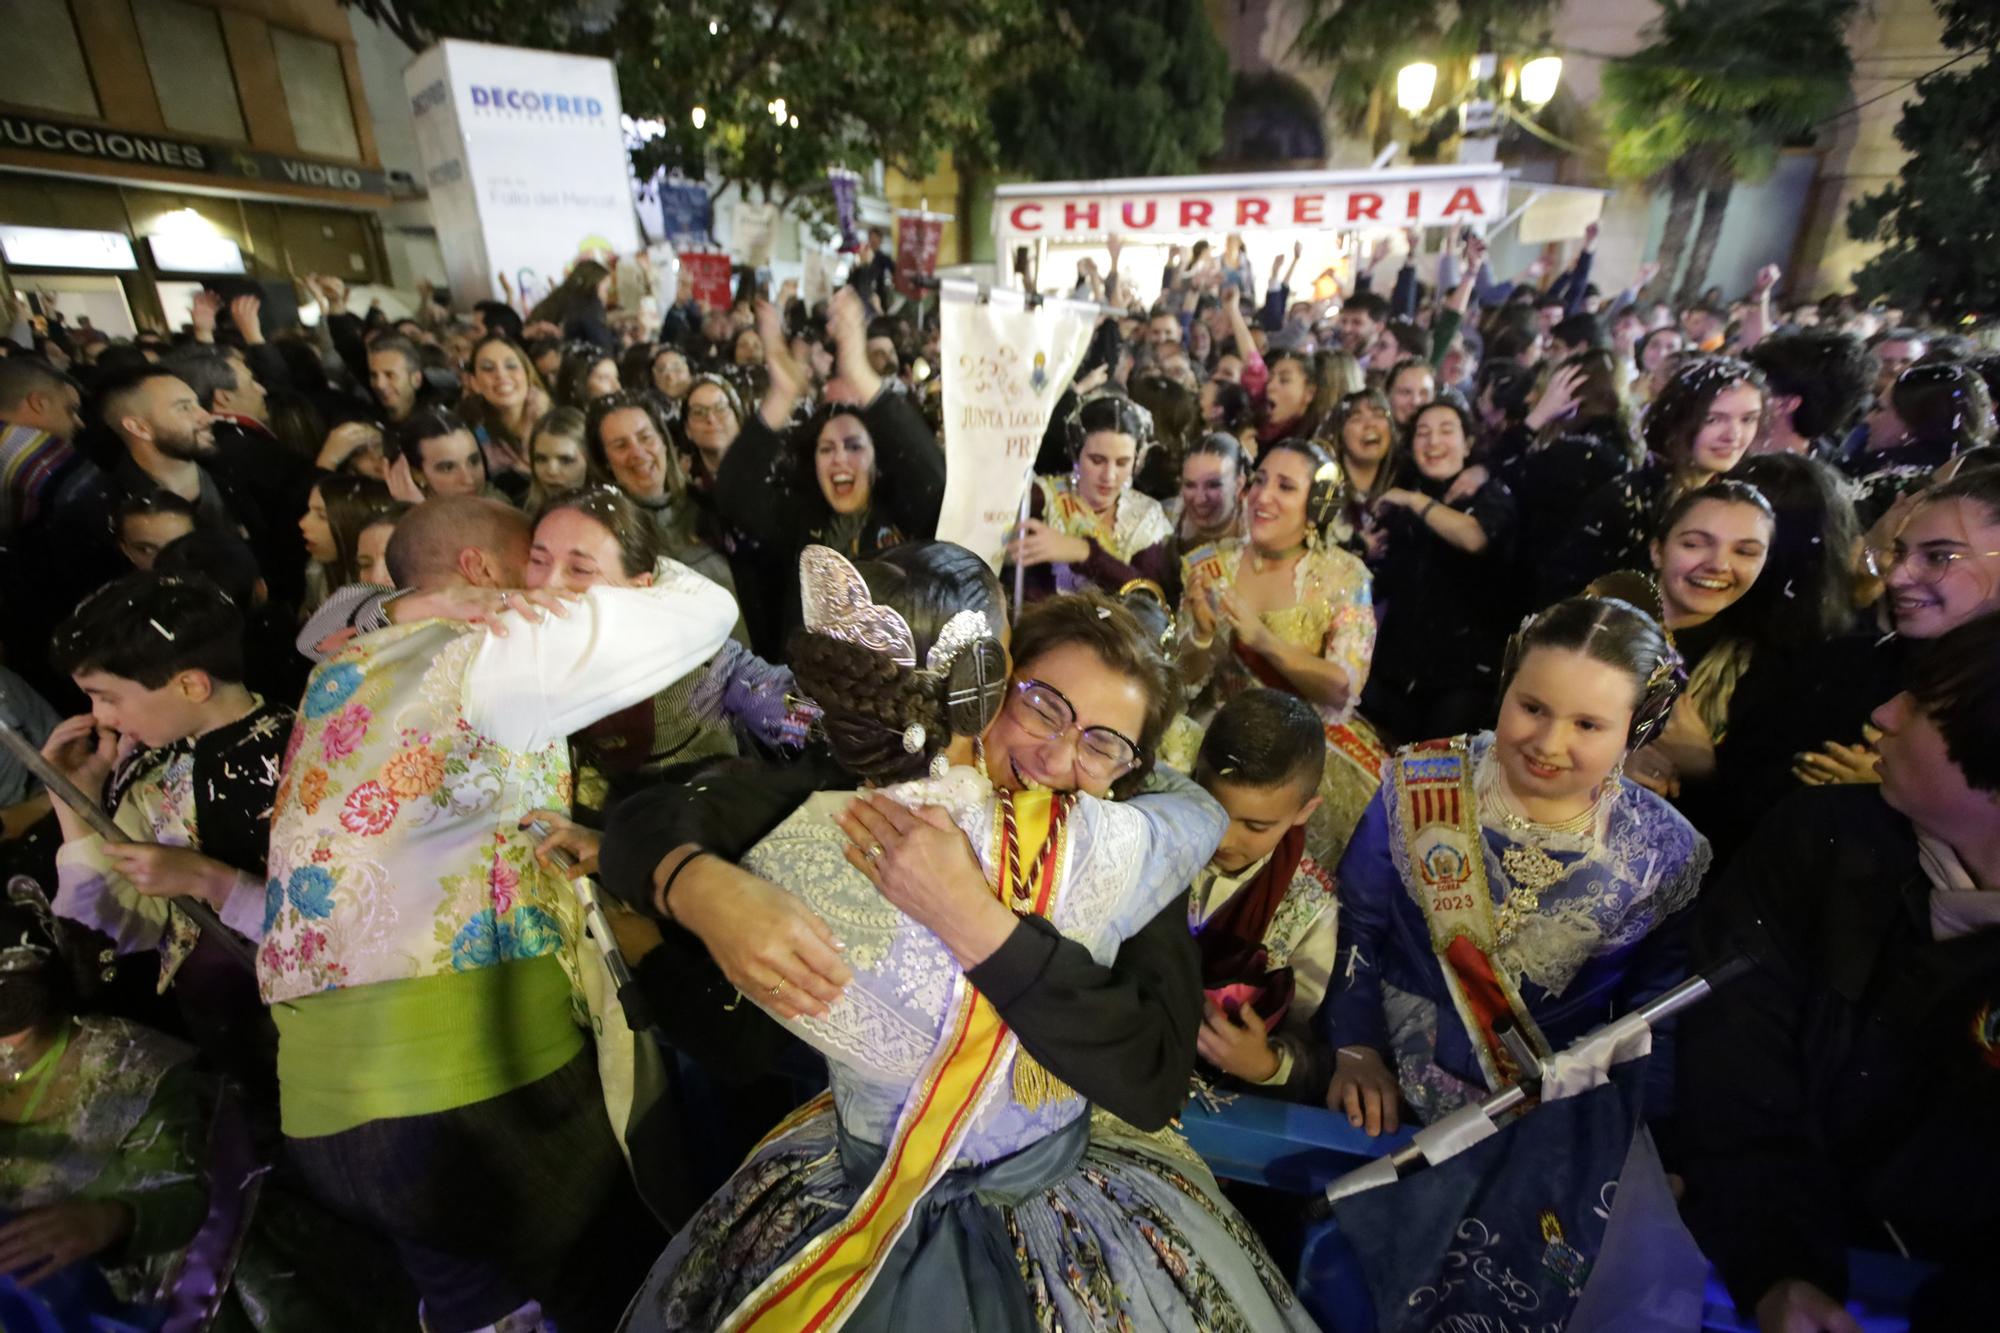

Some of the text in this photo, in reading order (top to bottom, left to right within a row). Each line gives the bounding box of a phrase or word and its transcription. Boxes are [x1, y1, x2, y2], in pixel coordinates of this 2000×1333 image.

[470, 84, 603, 118] DECOFRED
[0, 117, 362, 192] UCCIONES VIDEO
[1009, 185, 1485, 231] CHURRERIA
[961, 406, 1004, 430] JUNTA
[1432, 894, 1475, 912] 2023
